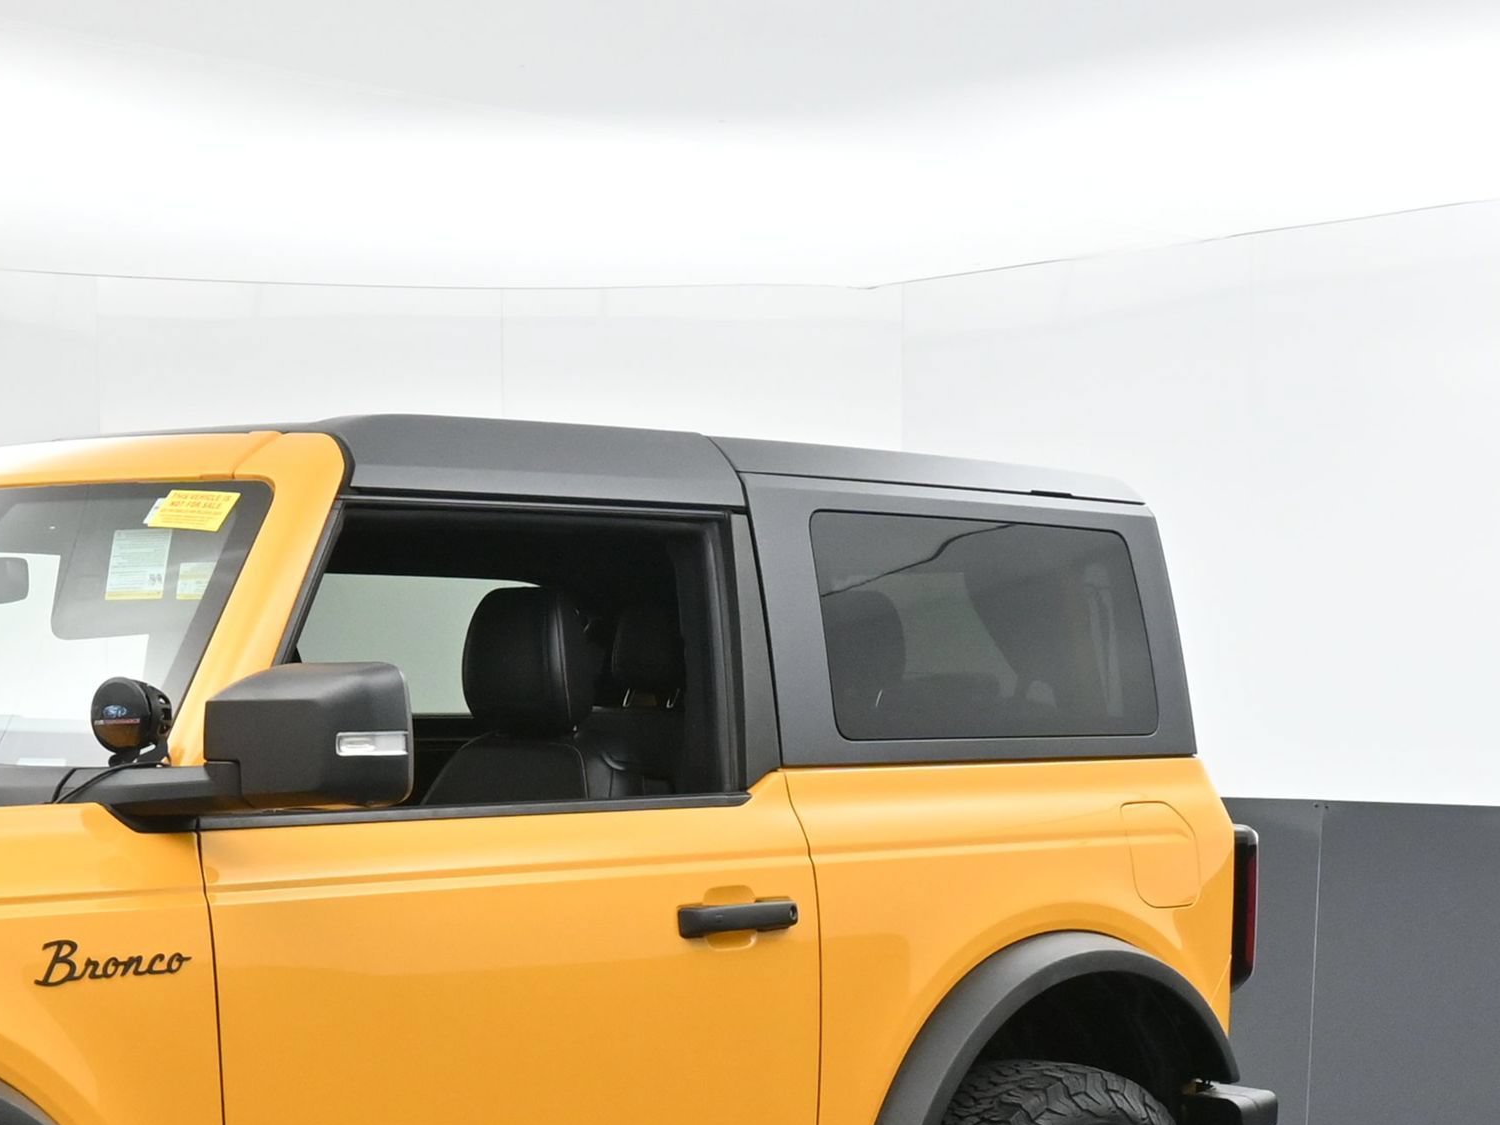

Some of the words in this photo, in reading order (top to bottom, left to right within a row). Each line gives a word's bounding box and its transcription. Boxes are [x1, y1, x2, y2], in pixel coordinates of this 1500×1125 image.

[169, 500, 185, 508] NOT
[202, 502, 222, 510] SALE
[33, 939, 192, 987] Bronco
